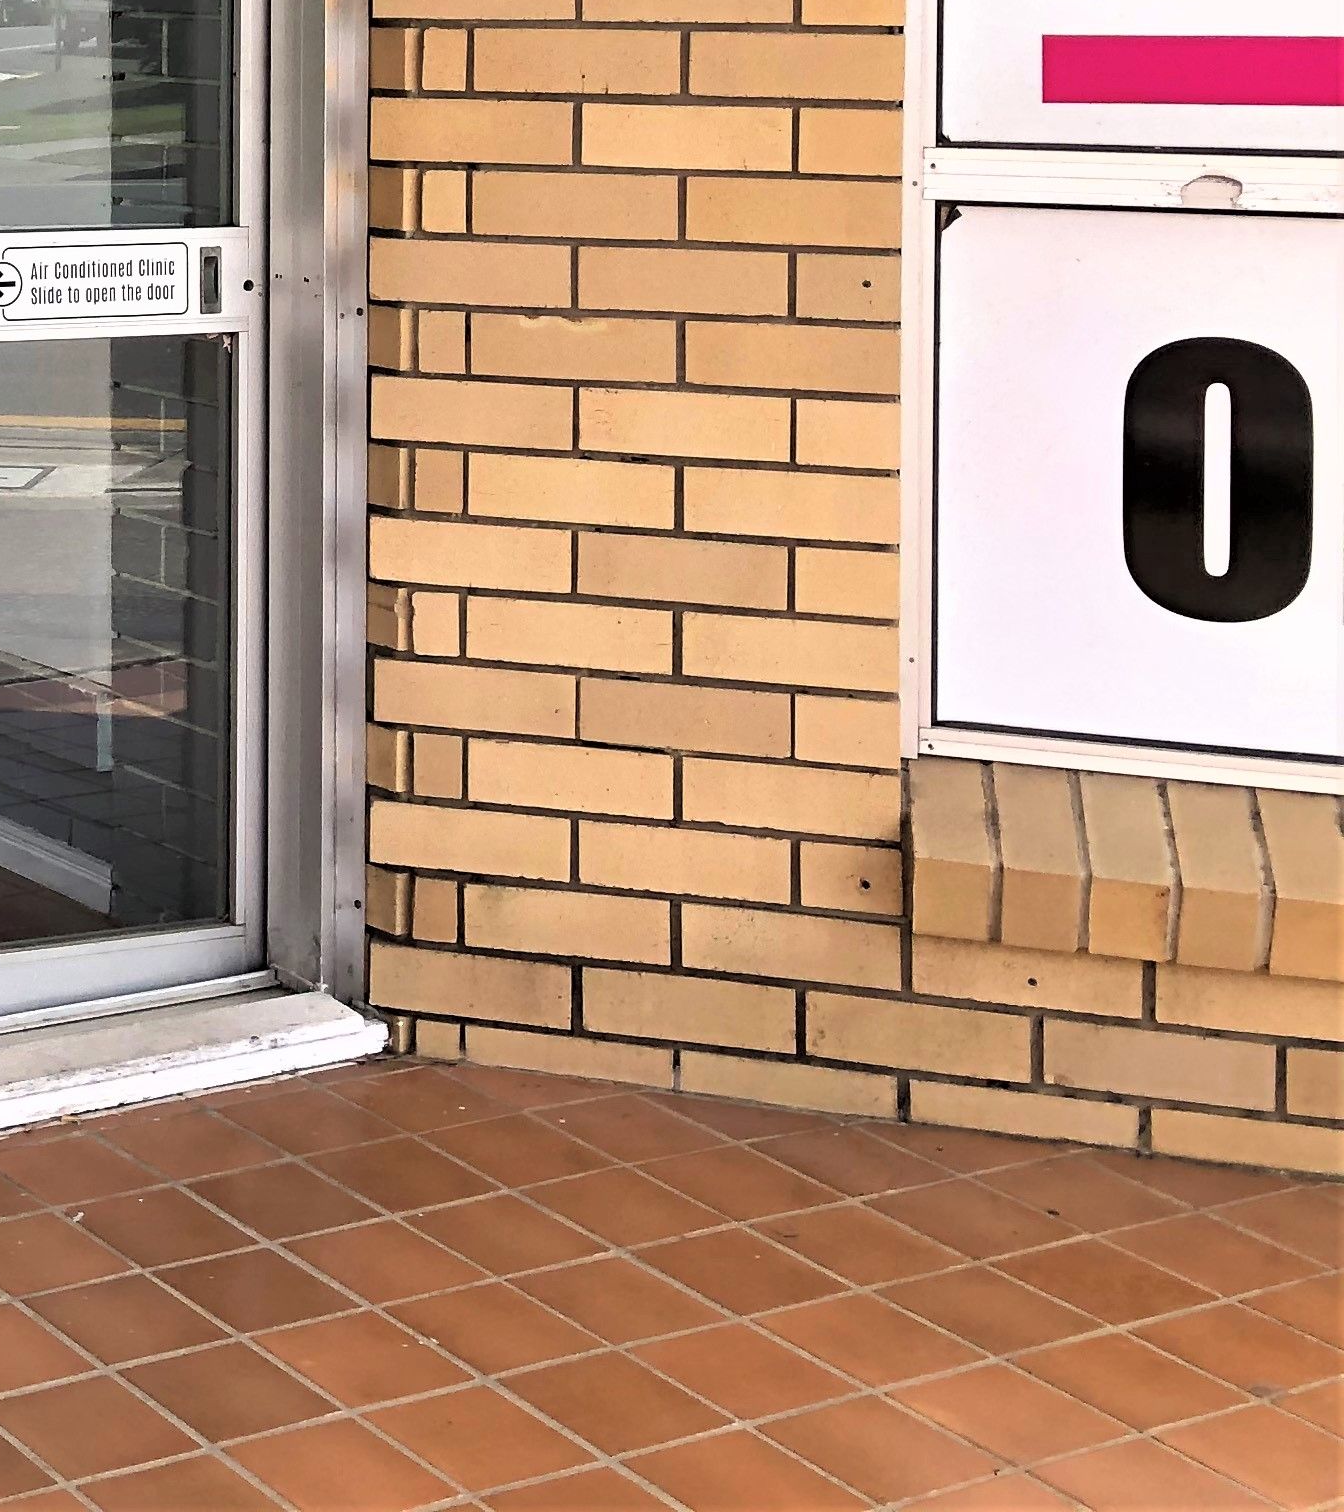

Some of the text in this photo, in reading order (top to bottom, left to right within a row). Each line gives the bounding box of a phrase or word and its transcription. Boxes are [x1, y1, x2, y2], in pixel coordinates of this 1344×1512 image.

[30, 257, 175, 280] Air Conditioned Clinic
[30, 282, 175, 305] Slide to open the door
